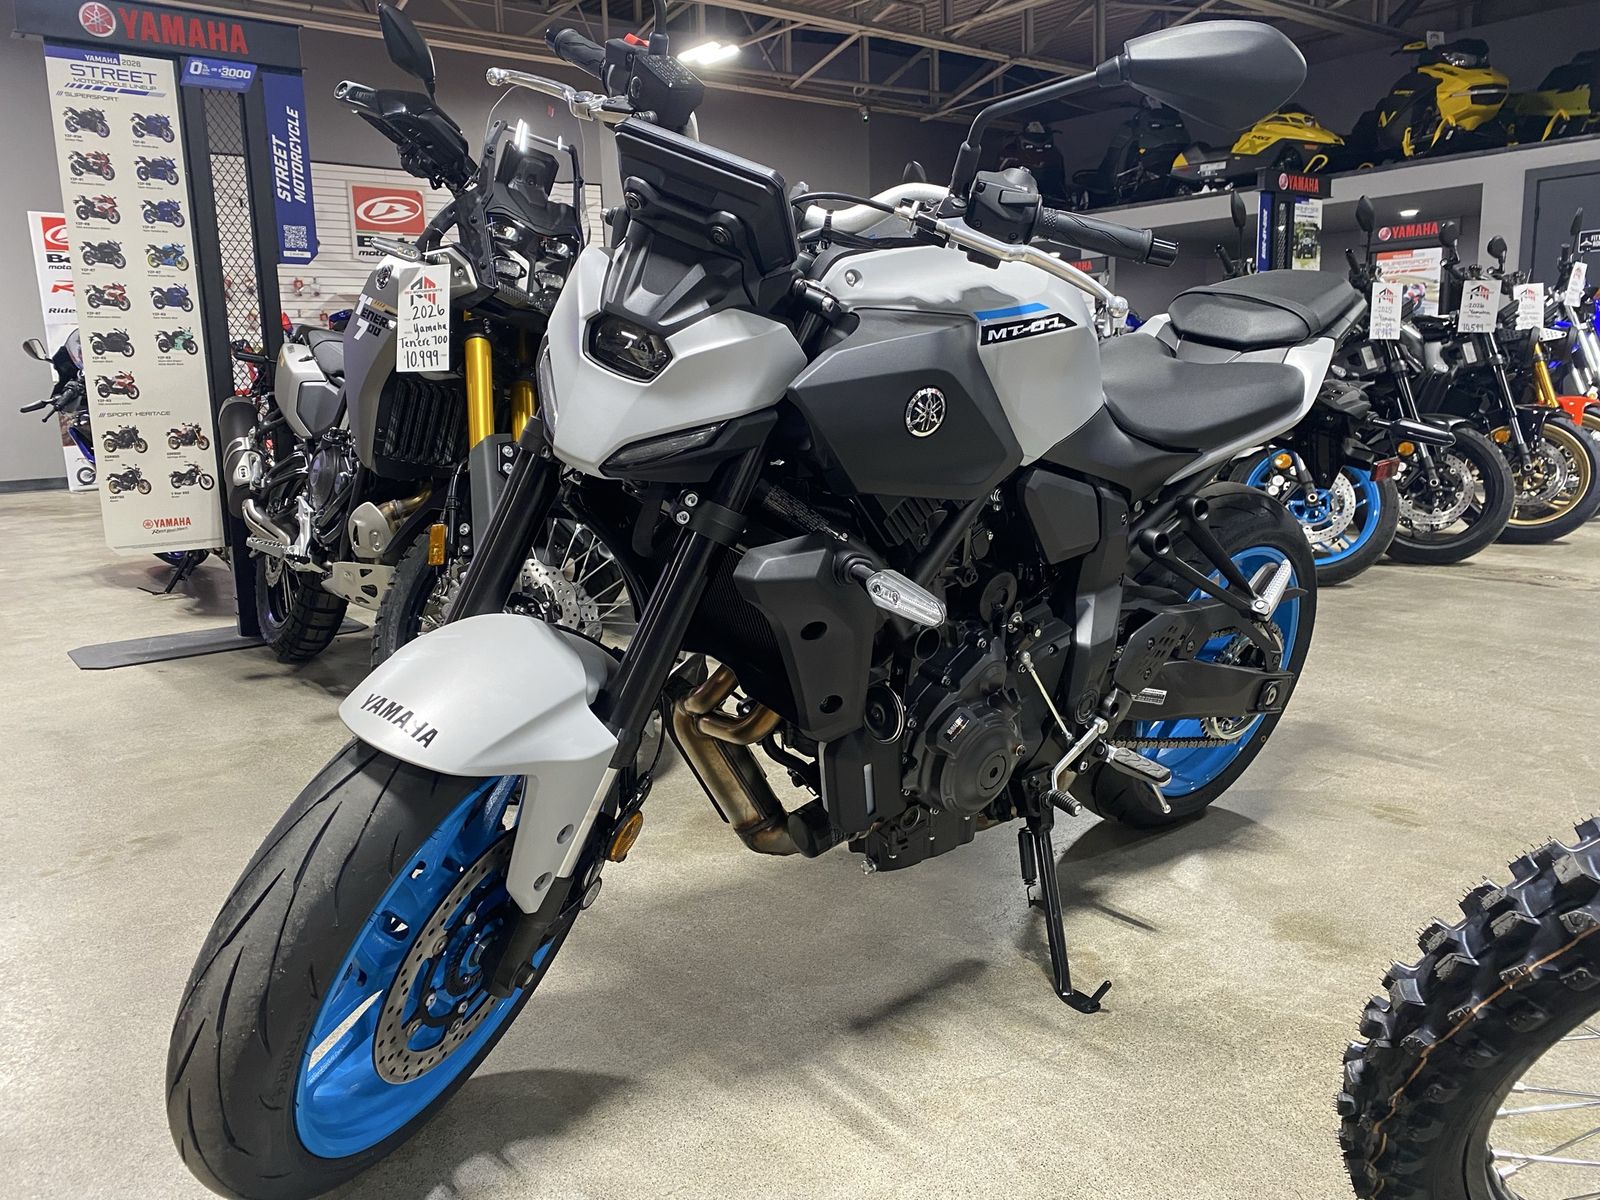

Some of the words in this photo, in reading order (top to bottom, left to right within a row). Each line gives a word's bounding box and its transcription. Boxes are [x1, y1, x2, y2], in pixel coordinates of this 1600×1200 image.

[117, 7, 249, 55] YAMAHA
[84, 54, 119, 65] YAMAHA
[121, 59, 141, 68] 2026
[69, 63, 157, 85] STREET
[72, 77, 128, 89] MOTORCYCLE
[129, 83, 157, 91] LINEUP
[64, 91, 119, 102] SUPERSPORT
[286, 105, 307, 204] MOTORCYCLE
[271, 134, 292, 203] STREET
[1288, 174, 1319, 193] YAMAHA
[1391, 221, 1439, 240] YAMAHA
[412, 304, 445, 320] 2026
[353, 320, 382, 341] 700
[413, 322, 448, 340] Yamaha
[987, 316, 1066, 341] MT-07
[431, 335, 448, 345] 700
[154, 516, 192, 528] YAMAHA
